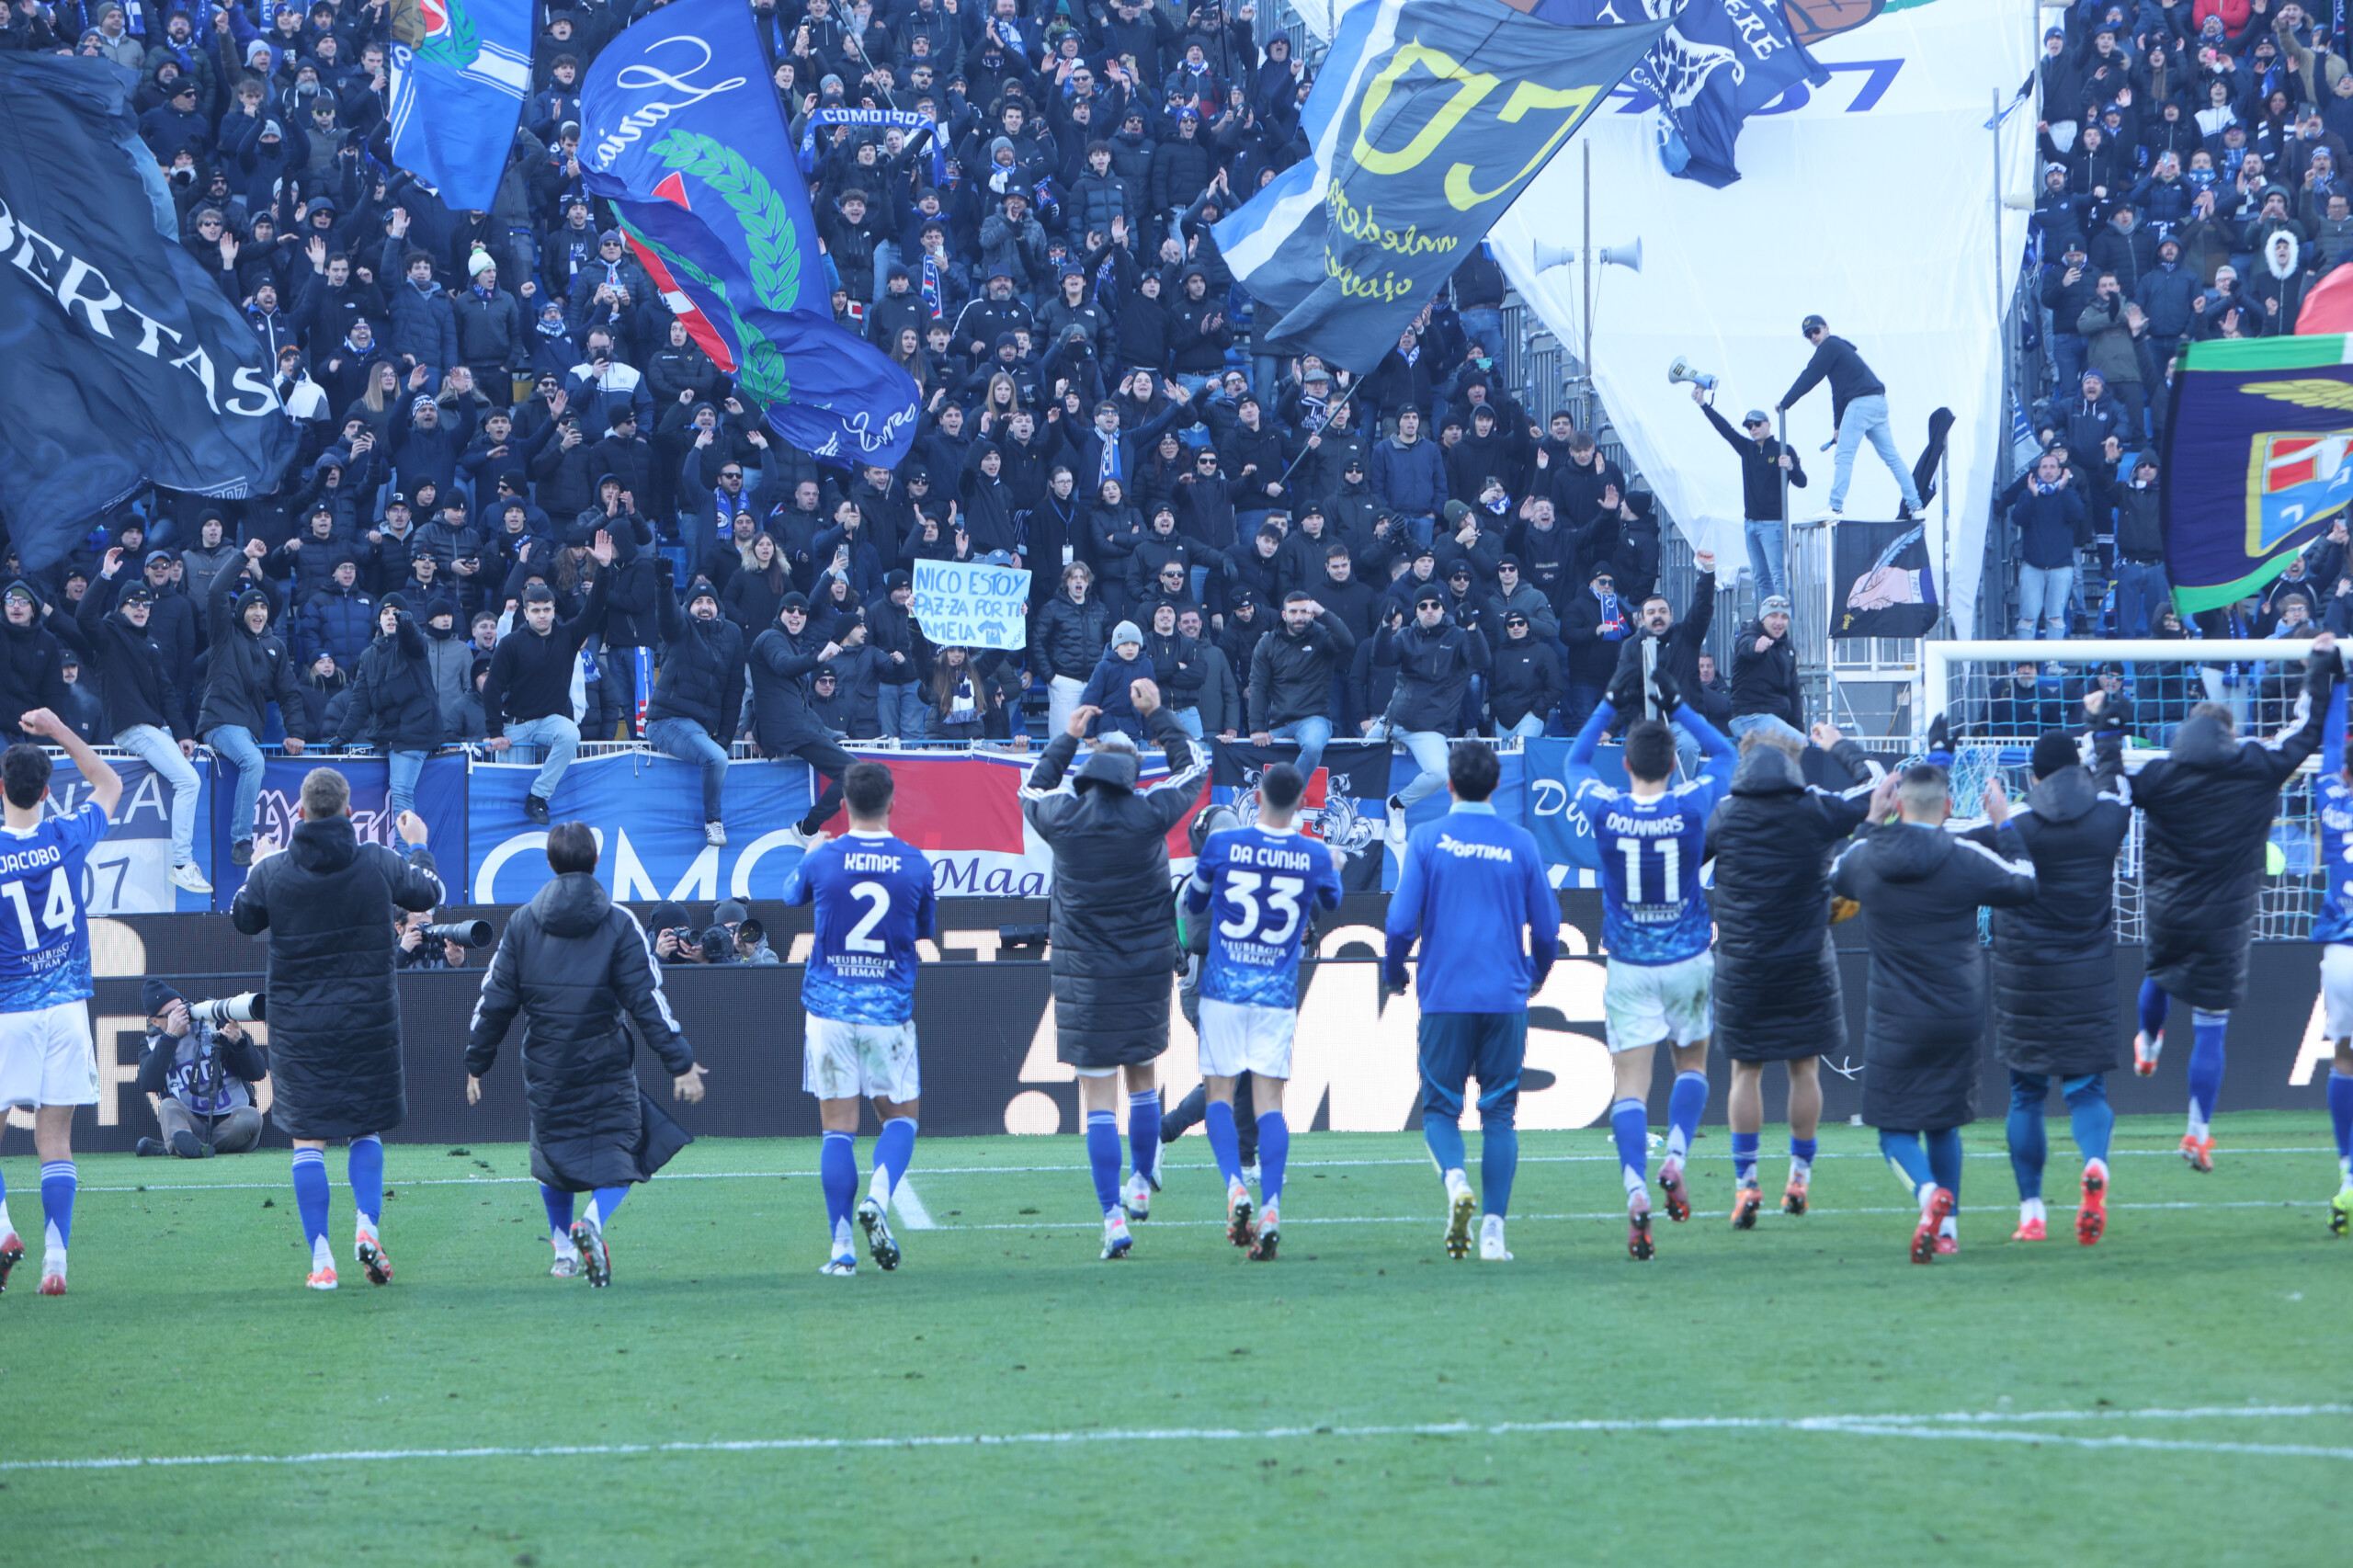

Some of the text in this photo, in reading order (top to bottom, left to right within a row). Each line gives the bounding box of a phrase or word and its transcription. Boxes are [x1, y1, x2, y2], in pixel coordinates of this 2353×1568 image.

[915, 566, 1027, 596] NICO ESTOY
[914, 592, 969, 618] PAZ-ZA
[974, 598, 1004, 618] POR
[844, 852, 902, 873] KEMPF
[1229, 843, 1311, 871] DA CUNHA
[1616, 837, 1680, 903] 11
[1, 865, 76, 951] 14
[845, 881, 891, 953] 2
[1219, 869, 1304, 945] 33
[826, 955, 896, 970] NEUBERGER
[836, 966, 885, 978] BERMAN
[1229, 951, 1276, 966] BERMAN
